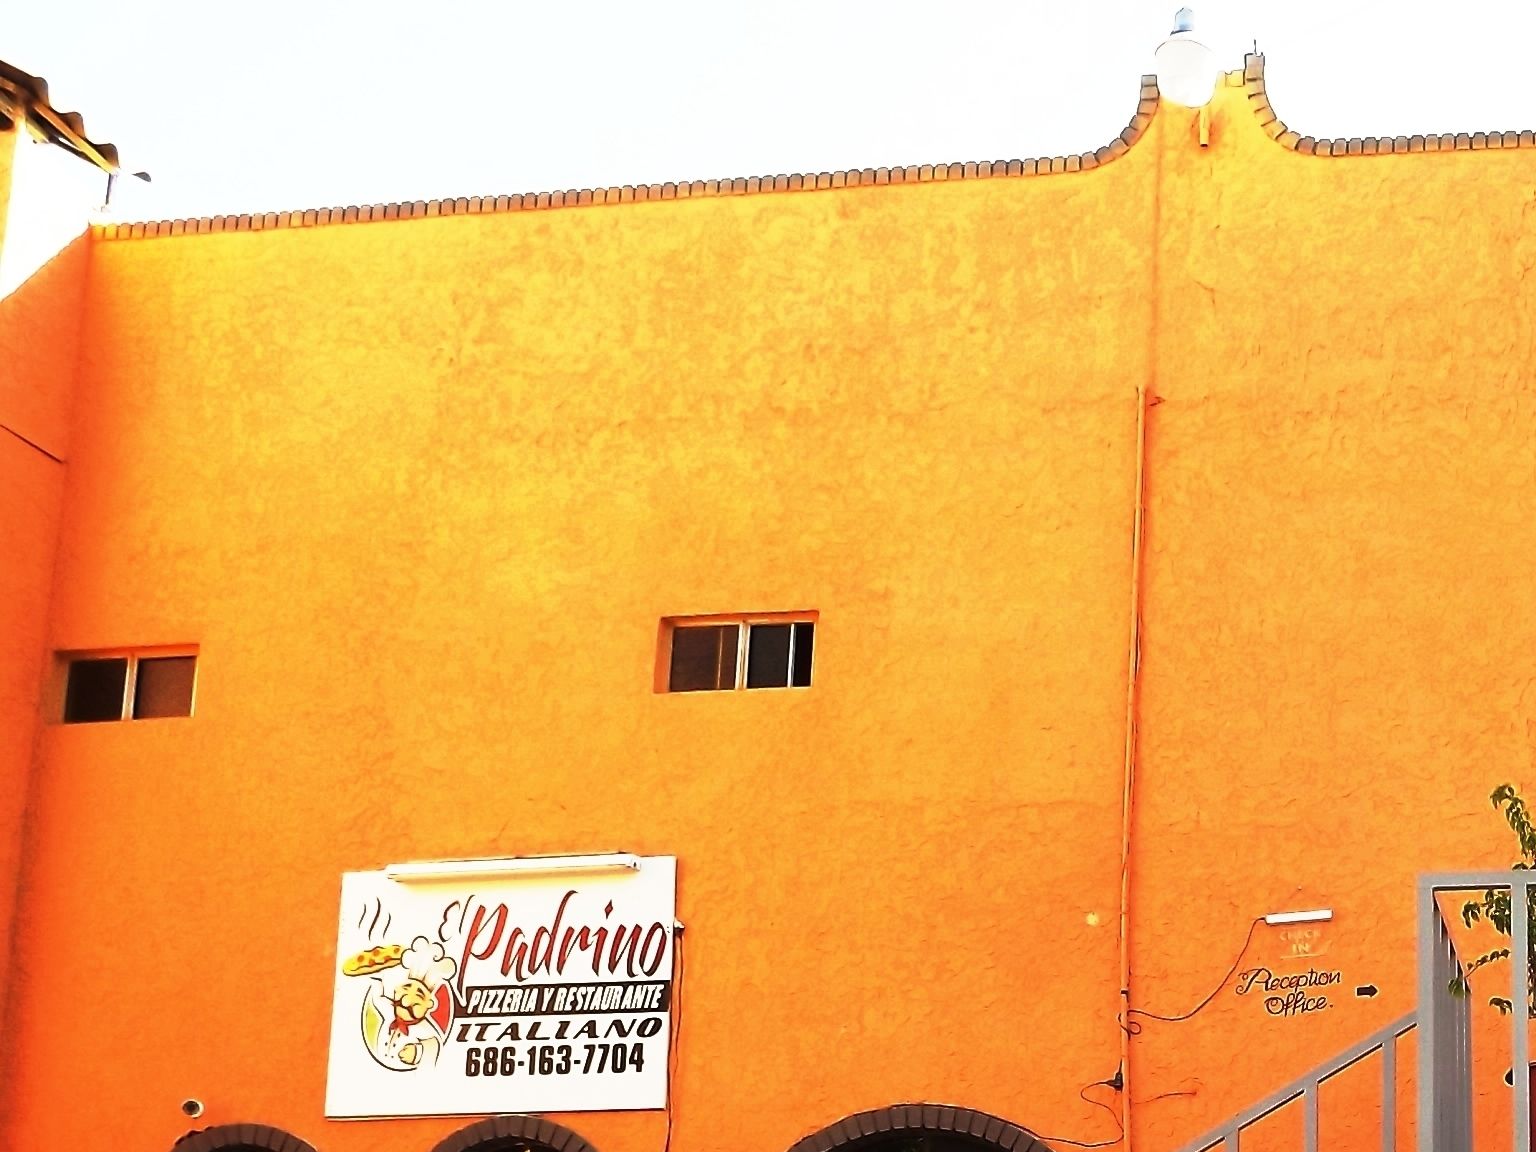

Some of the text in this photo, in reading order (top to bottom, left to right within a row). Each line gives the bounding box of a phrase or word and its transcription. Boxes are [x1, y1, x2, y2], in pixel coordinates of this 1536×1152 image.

[457, 890, 667, 1001] Padrino
[1235, 968, 1341, 995] Reception
[467, 985, 665, 1014] PIZZERIA Y RESTAURANTE
[456, 1017, 663, 1042] ITALIANO
[465, 1043, 645, 1077] 686-163-7704
